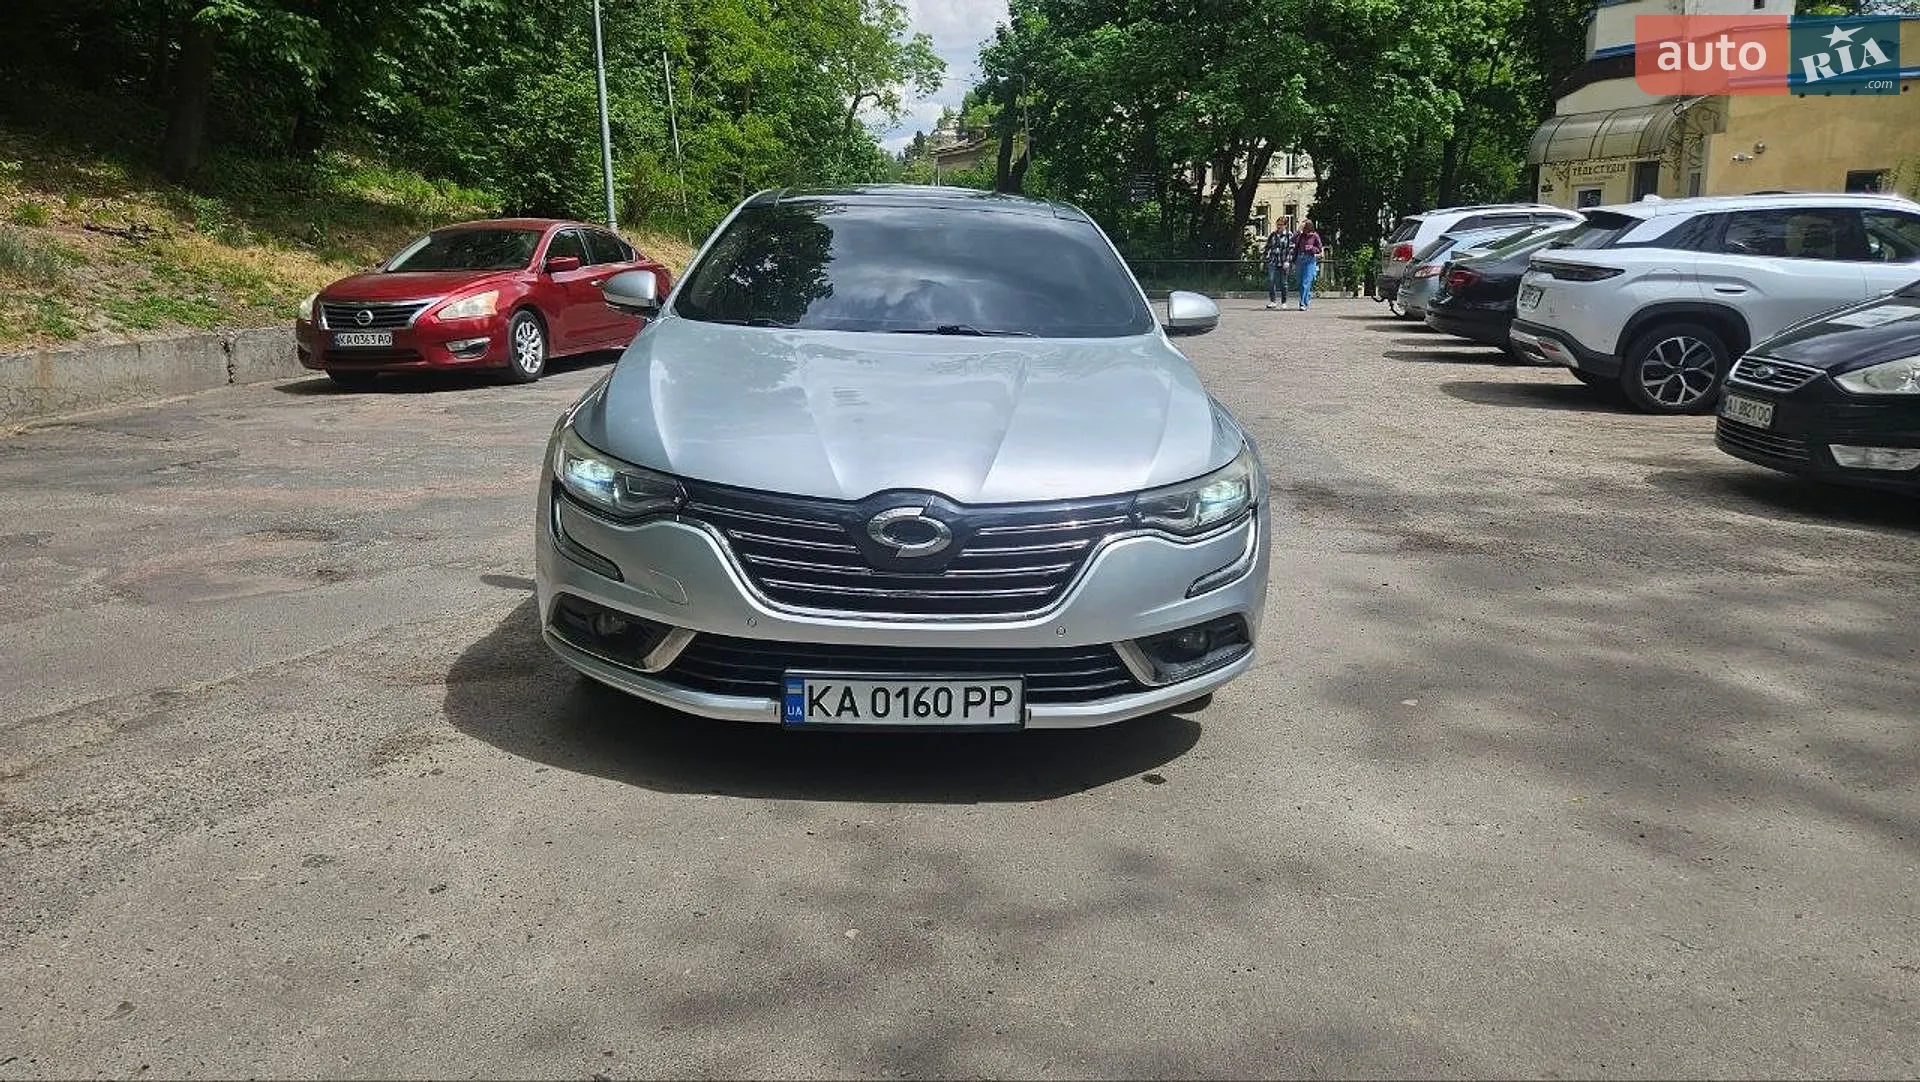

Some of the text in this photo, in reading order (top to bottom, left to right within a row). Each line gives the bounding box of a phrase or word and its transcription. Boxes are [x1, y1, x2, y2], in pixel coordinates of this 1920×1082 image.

[787, 705, 802, 715] UA
[807, 685, 1013, 718] KA 0160 PP
